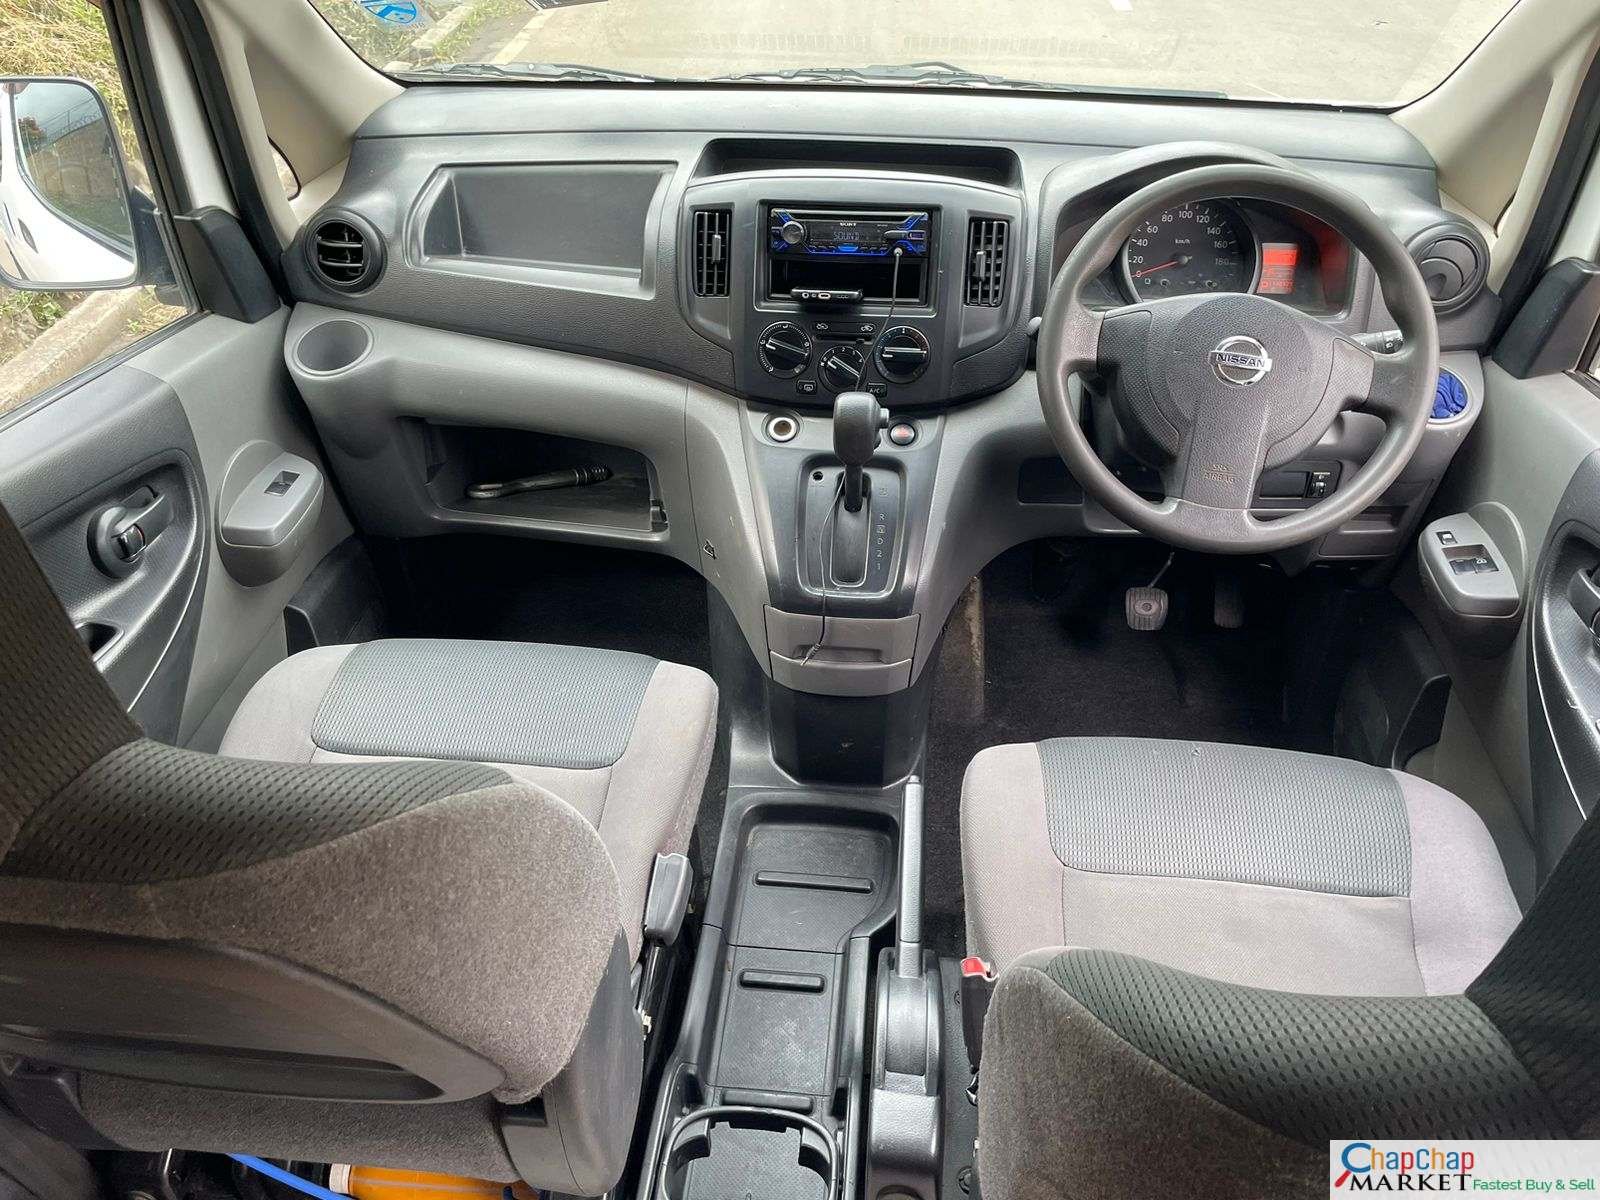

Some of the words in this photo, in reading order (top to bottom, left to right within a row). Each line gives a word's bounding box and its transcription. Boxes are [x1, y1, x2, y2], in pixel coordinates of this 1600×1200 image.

[1161, 214, 1173, 222] 80
[1178, 210, 1193, 219] 100
[1196, 215, 1210, 223] 120
[1146, 225, 1159, 234] 60
[1207, 227, 1221, 235] 140
[1136, 238, 1148, 247] 40
[1214, 241, 1228, 249] 160
[1132, 256, 1144, 264] 20
[1136, 270, 1142, 278] 0
[1216, 353, 1266, 368] NISSAN
